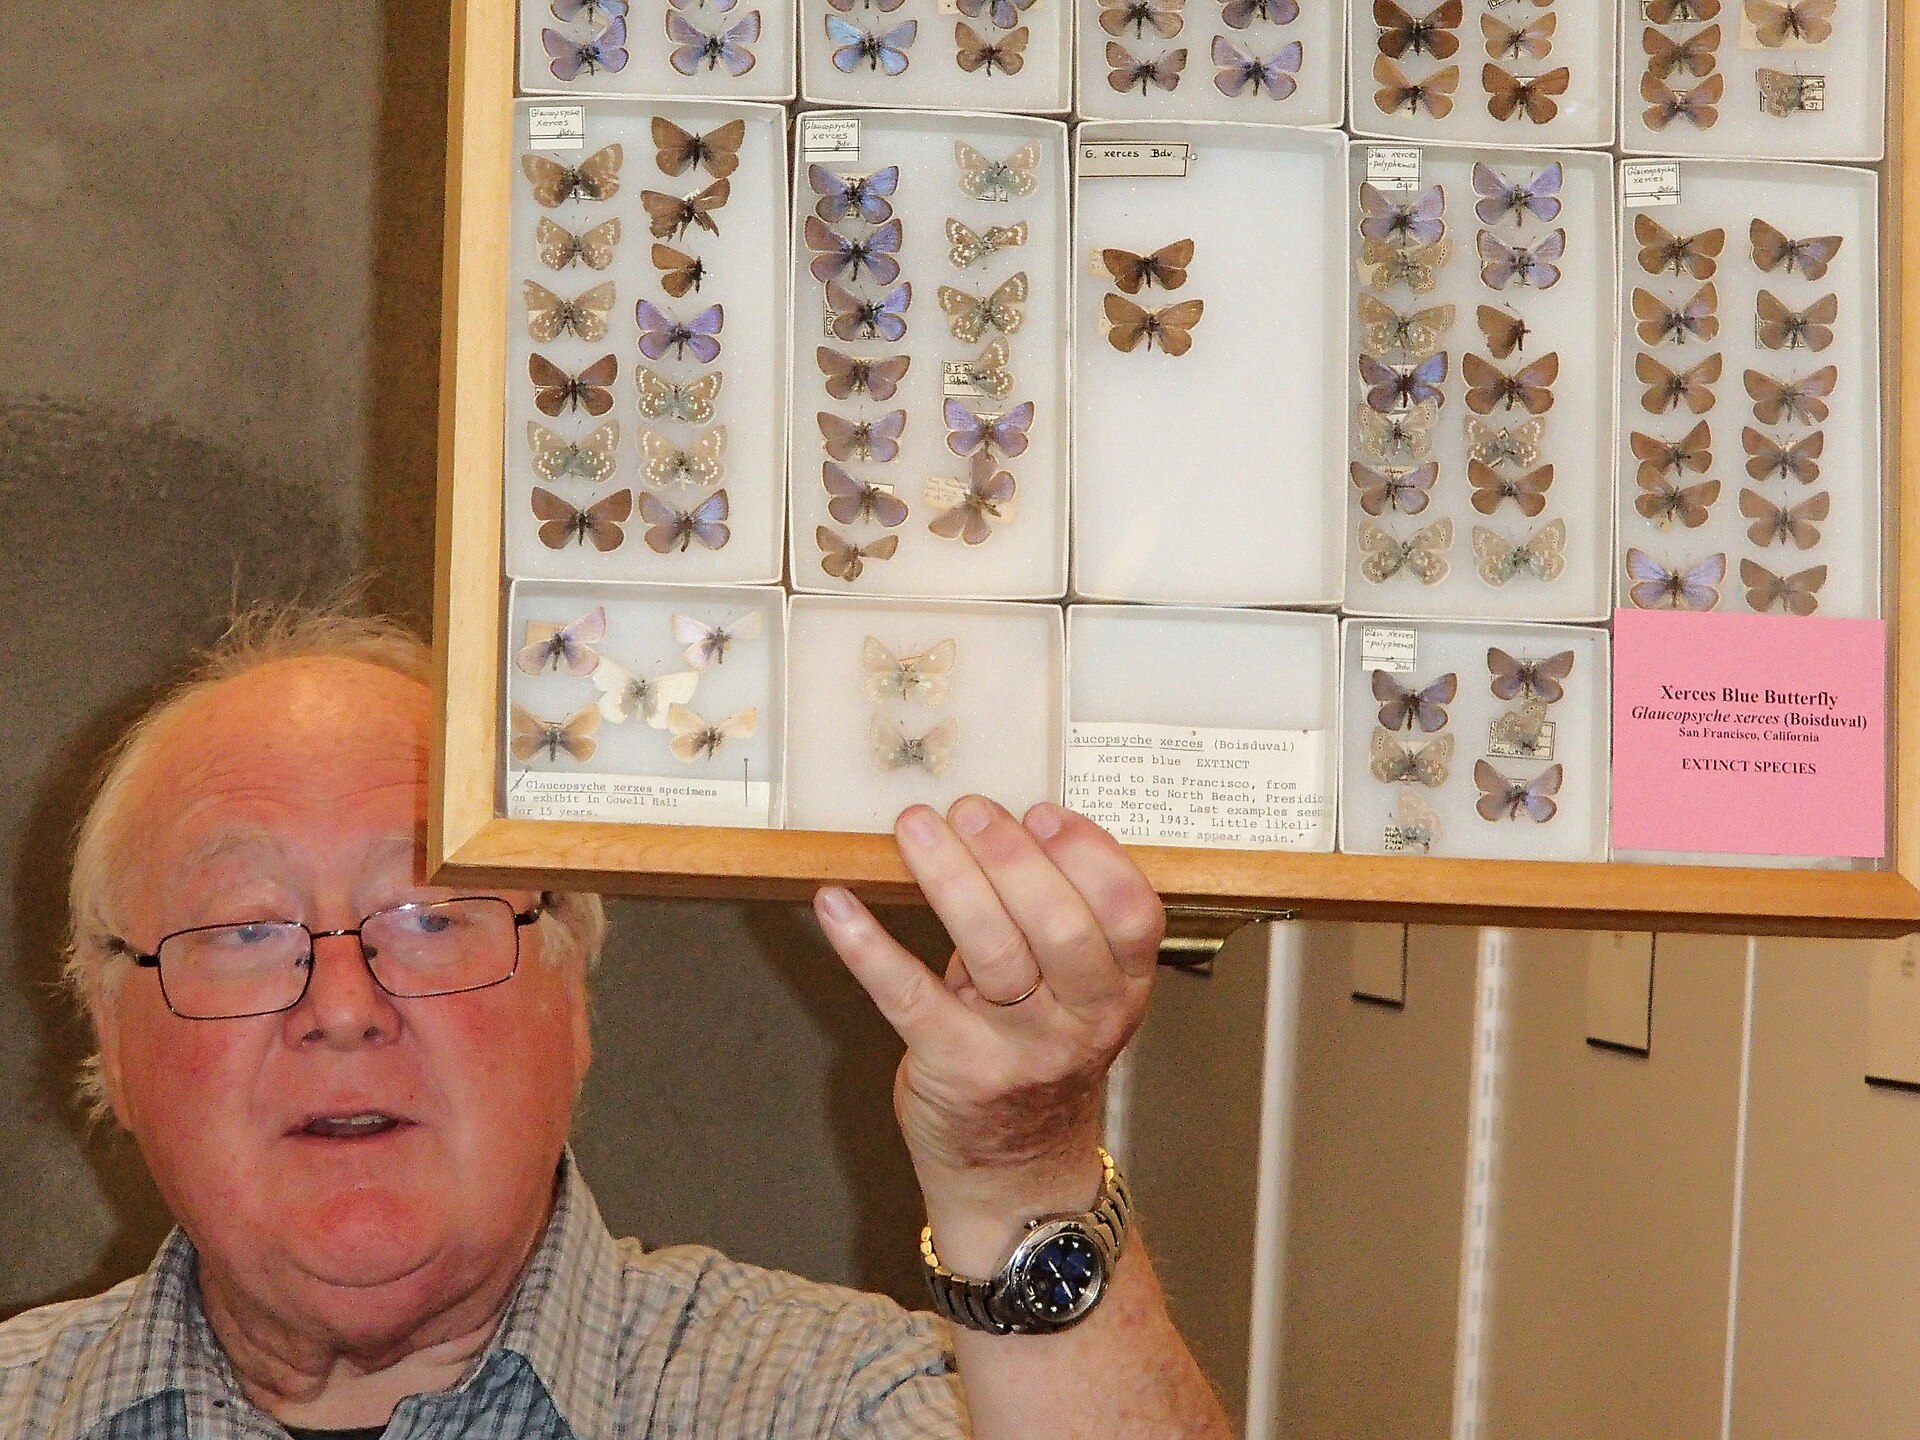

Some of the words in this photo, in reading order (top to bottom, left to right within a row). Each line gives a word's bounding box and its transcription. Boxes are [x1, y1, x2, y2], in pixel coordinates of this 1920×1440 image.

[1085, 150, 1097, 159] G.
[1150, 149, 1176, 158] Bdv.
[1660, 685, 1716, 701] Xerces
[1722, 688, 1759, 703] Blue
[1764, 689, 1838, 710] Butterfly
[1631, 706, 1731, 725] Glaucopsyche
[1733, 713, 1780, 724] xerces
[1784, 712, 1868, 731] (Boisduval)
[1070, 735, 1152, 747] aucopsyche
[1160, 739, 1203, 748] xerces
[1214, 739, 1295, 752] (Boisduval)
[1679, 727, 1700, 738] San
[1763, 730, 1820, 743] California
[1097, 753, 1144, 764] Xerces
[1152, 755, 1181, 766] blue
[1196, 758, 1250, 769] EXTINCT
[1682, 758, 1749, 772] EXTINCT
[1754, 760, 1817, 774] SPECIES
[526, 780, 606, 793] Glaucopsyche
[613, 784, 652, 793] xerxes
[659, 787, 717, 797] specimens
[1130, 775, 1144, 783] to
[1152, 775, 1174, 785] San
[1181, 777, 1255, 790] Francisco,
[1266, 780, 1297, 790] from
[533, 793, 580, 804] exhibit
[588, 794, 600, 804] in
[606, 795, 645, 805] Cowell
[652, 797, 677, 807] Hall
[1098, 786, 1137, 796] Peaks
[1145, 788, 1160, 798] to
[1167, 788, 1204, 800] North
[1211, 792, 1256, 804] Beach,
[1265, 794, 1324, 804] Presidio
[540, 806, 552, 816] 15
[559, 809, 599, 818] years.
[1082, 799, 1113, 809] Lake
[1120, 801, 1172, 811] Merced.
[1189, 804, 1219, 814] Last
[1226, 807, 1288, 818] examples
[1129, 813, 1151, 824] 23,
[1160, 814, 1195, 826] 1943.
[1211, 819, 1258, 829] Little
[1265, 821, 1317, 831] likeli-
[1120, 826, 1150, 836] will
[1160, 829, 1189, 838] ever
[1196, 832, 1241, 842] appear
[1250, 833, 1294, 844] again.
